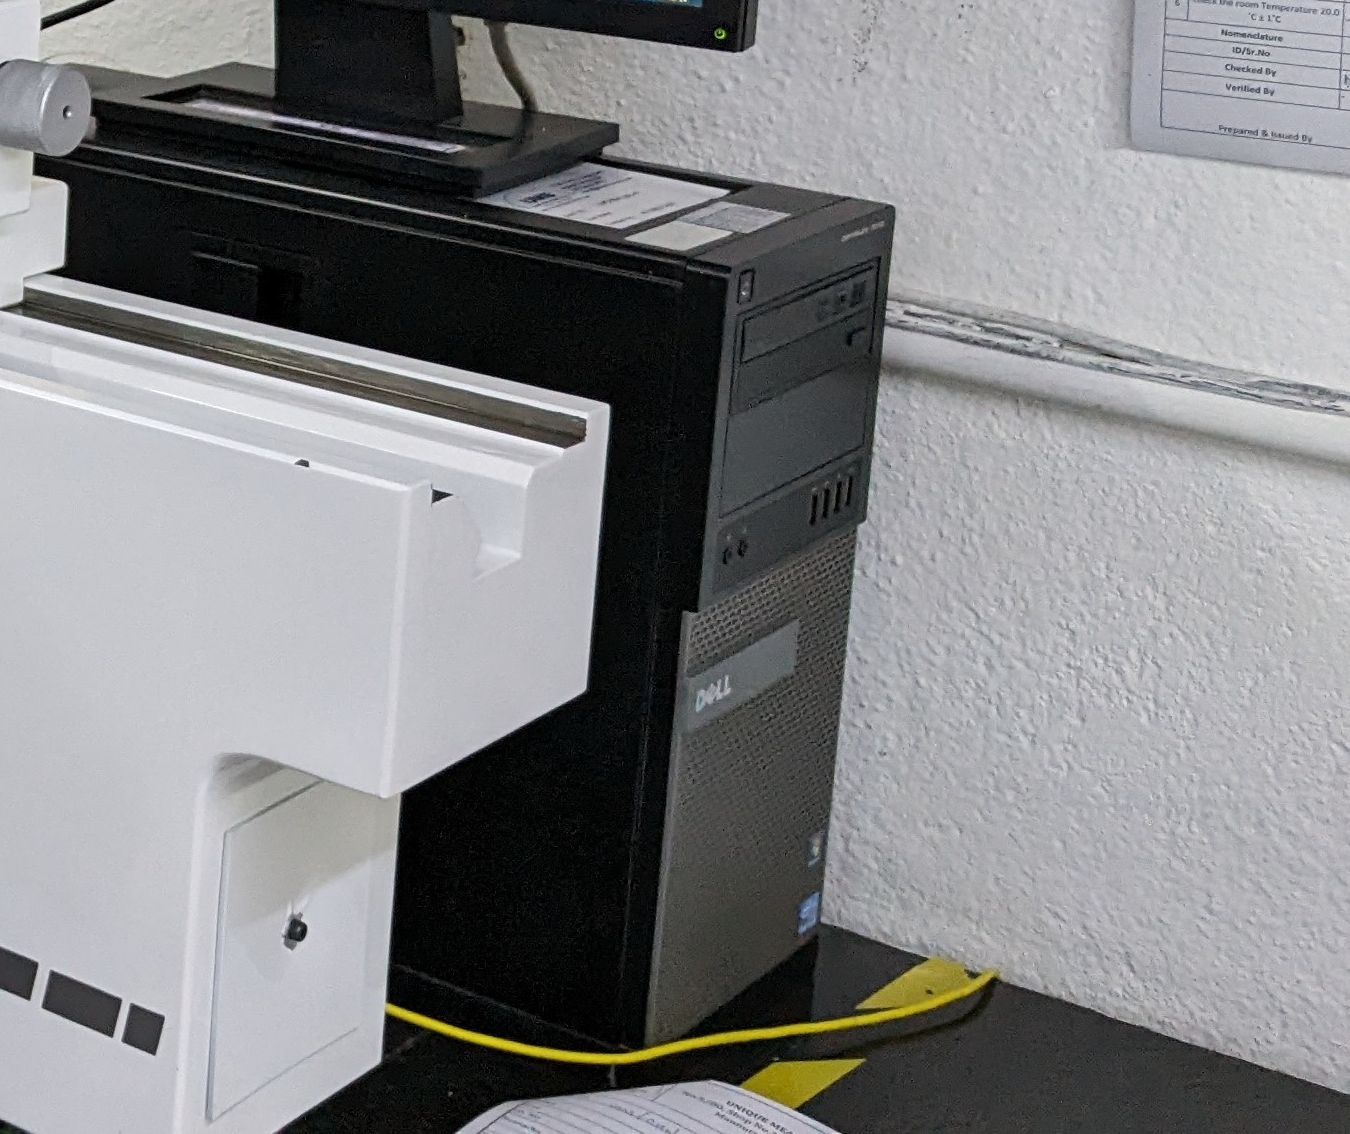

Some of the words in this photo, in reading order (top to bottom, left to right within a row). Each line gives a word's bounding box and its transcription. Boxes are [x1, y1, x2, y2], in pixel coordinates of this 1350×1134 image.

[1175, 0, 1180, 7] 6
[1235, 0, 1259, 9] room
[1261, 2, 1320, 15] Temperature
[1221, 28, 1284, 42] Nomenclature
[1232, 46, 1271, 57] ID/Sr.No
[1224, 63, 1263, 75] Checked
[1265, 67, 1277, 77] By
[1225, 82, 1261, 94] Verified
[1263, 86, 1275, 96] By
[1218, 124, 1259, 137] Prepared
[1261, 129, 1268, 137] &
[1271, 131, 1299, 141] Issued
[1301, 133, 1313, 143] By
[695, 674, 732, 713] DELL
[726, 1100, 769, 1123] UNIQUE
